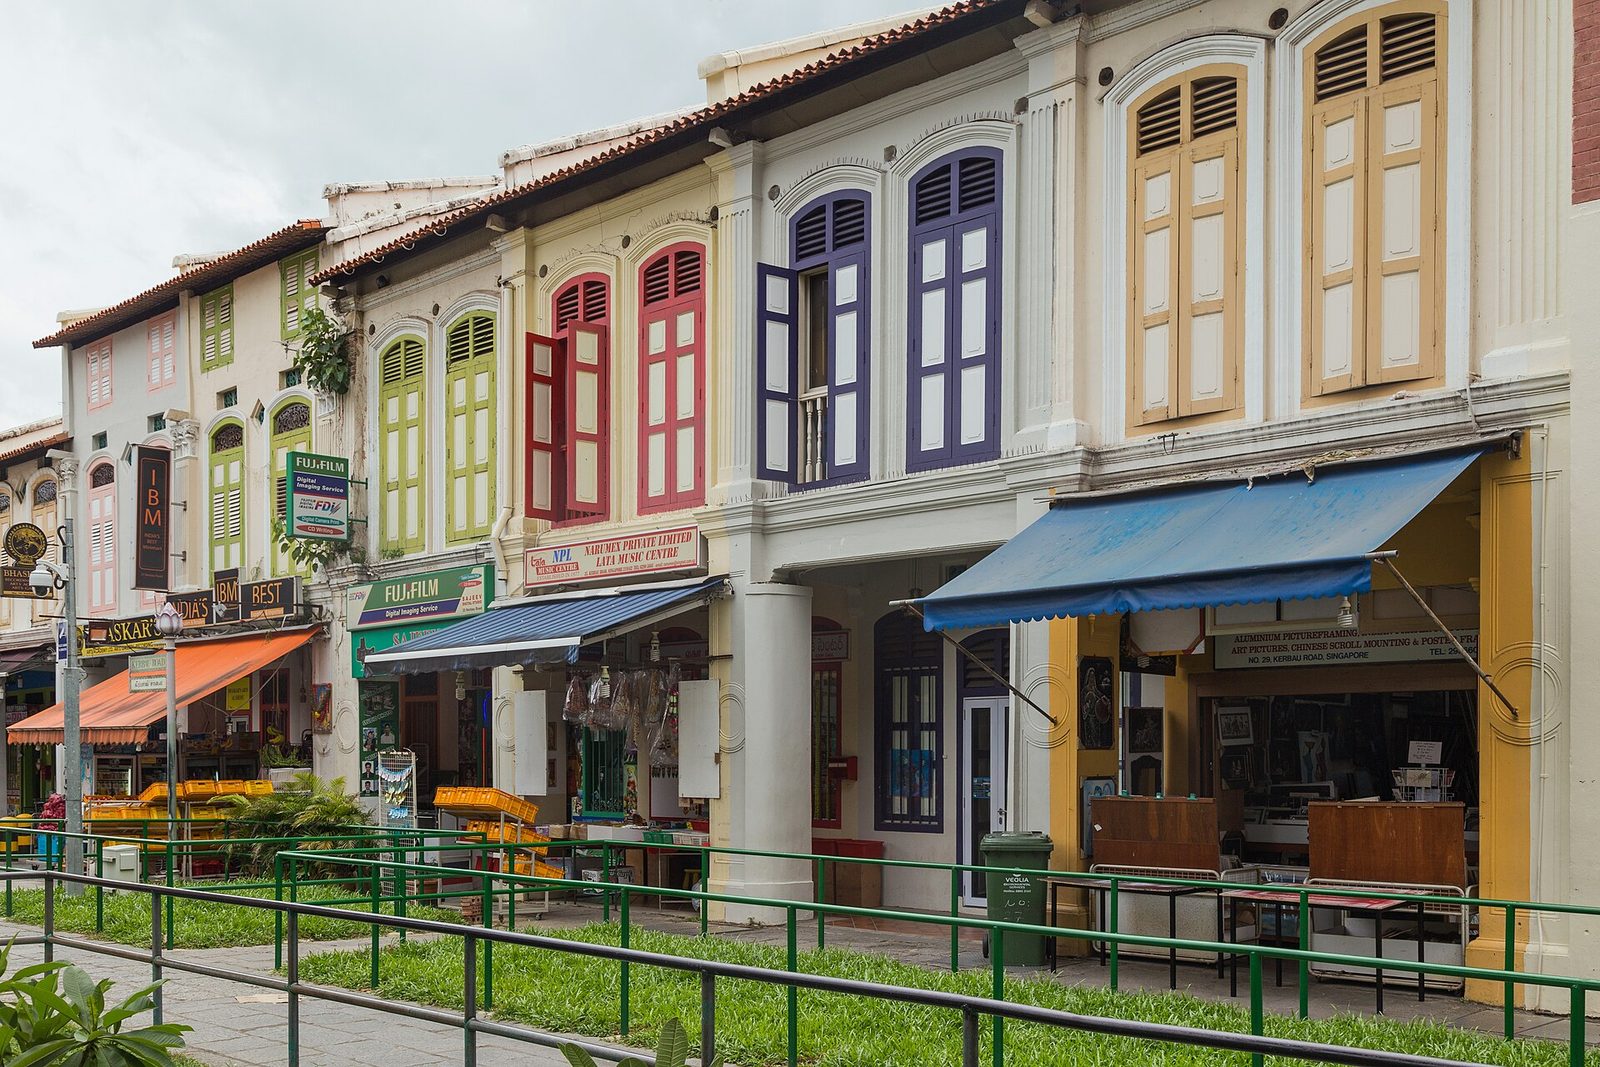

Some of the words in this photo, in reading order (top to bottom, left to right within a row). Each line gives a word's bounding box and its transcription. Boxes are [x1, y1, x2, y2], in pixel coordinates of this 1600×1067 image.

[296, 456, 344, 472] FUJIFILM
[296, 476, 317, 484] Digital
[296, 482, 321, 491] Imaging
[322, 485, 344, 493] Service
[144, 469, 161, 526] IBM
[584, 541, 622, 556] NARUMEX
[623, 537, 657, 551] PRIVATE
[658, 531, 692, 546] LIMITED
[552, 548, 572, 563] NPL
[596, 554, 615, 568] LATA
[617, 550, 644, 565] MUSIC
[645, 546, 679, 561] CENTRE
[4, 569, 30, 578] BHAS
[537, 565, 556, 575] MUSIC
[556, 563, 577, 573] CENTRE
[216, 581, 238, 603] IBM
[252, 582, 282, 604] BEST
[385, 578, 439, 602] FUJIFILM
[172, 597, 208, 620] NDIA'S
[386, 608, 400, 618] Digital
[401, 606, 419, 617] Imaging
[420, 604, 438, 613] Service
[1234, 633, 1281, 643] ALUMINIUM
[1231, 646, 1247, 655] ART
[1291, 642, 1328, 652] CHINESE
[1329, 640, 1362, 650] SCROLL
[1363, 638, 1411, 648] MOUNTING
[1273, 654, 1301, 663] KERBAU
[1326, 651, 1369, 660] SINGAPORE
